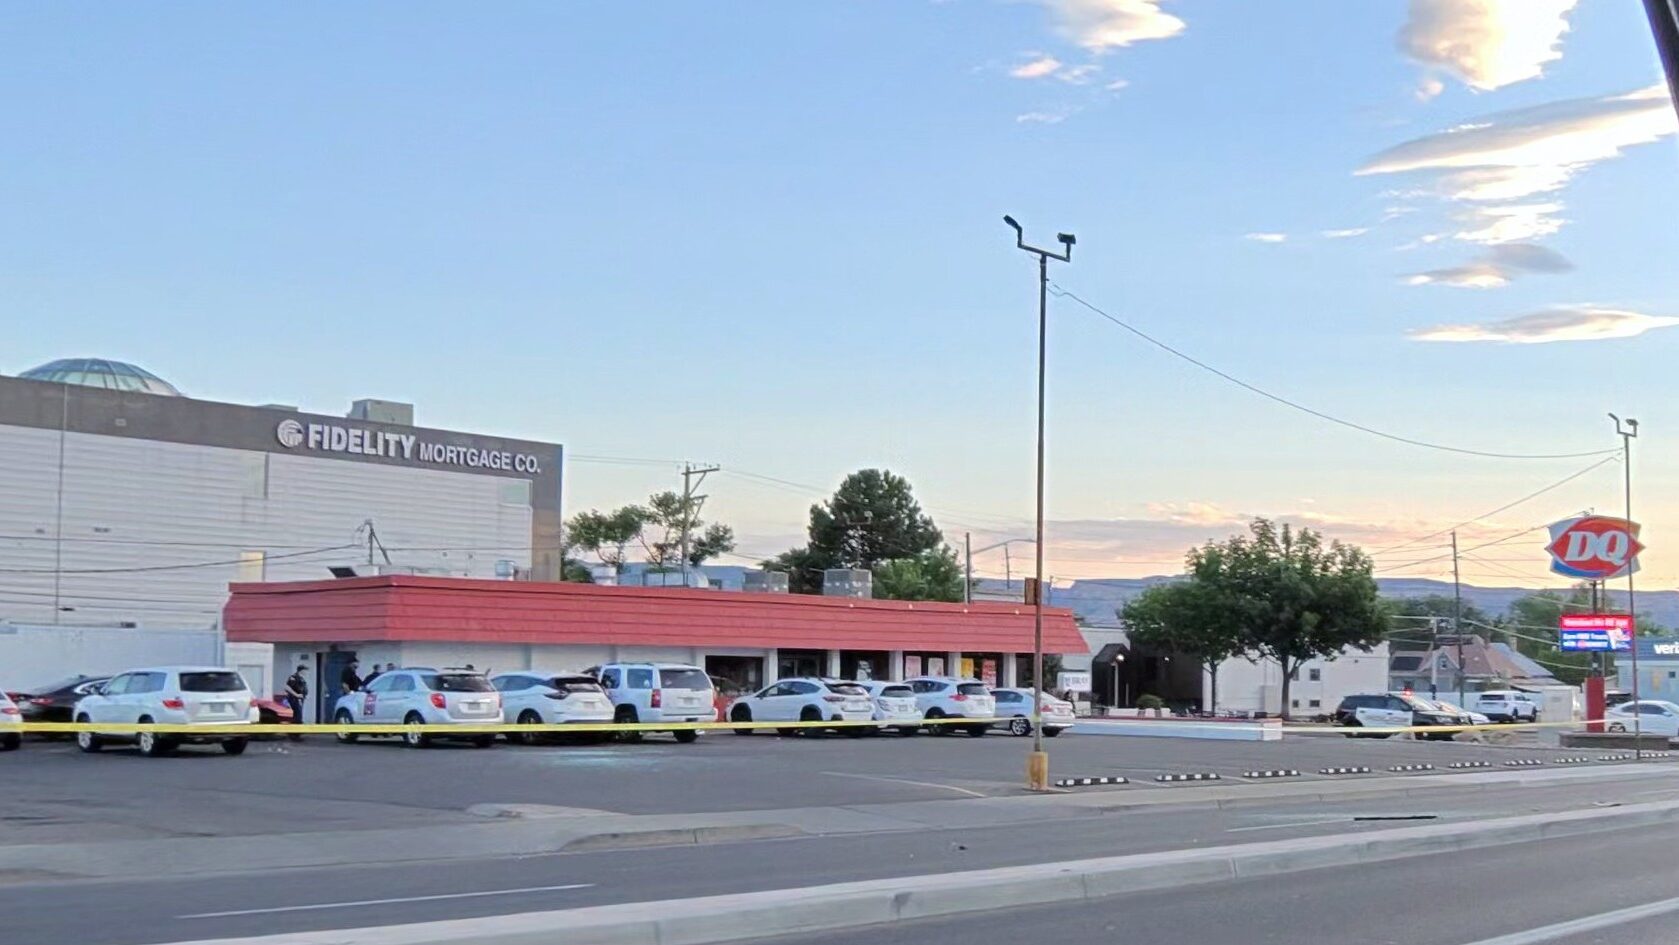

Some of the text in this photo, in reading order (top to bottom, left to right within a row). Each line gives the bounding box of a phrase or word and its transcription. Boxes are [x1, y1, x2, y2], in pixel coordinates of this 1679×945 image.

[307, 423, 541, 473] FIDELITY MORTGAGE CO.
[1564, 530, 1629, 566] DQ
[1653, 641, 1679, 655] veri
